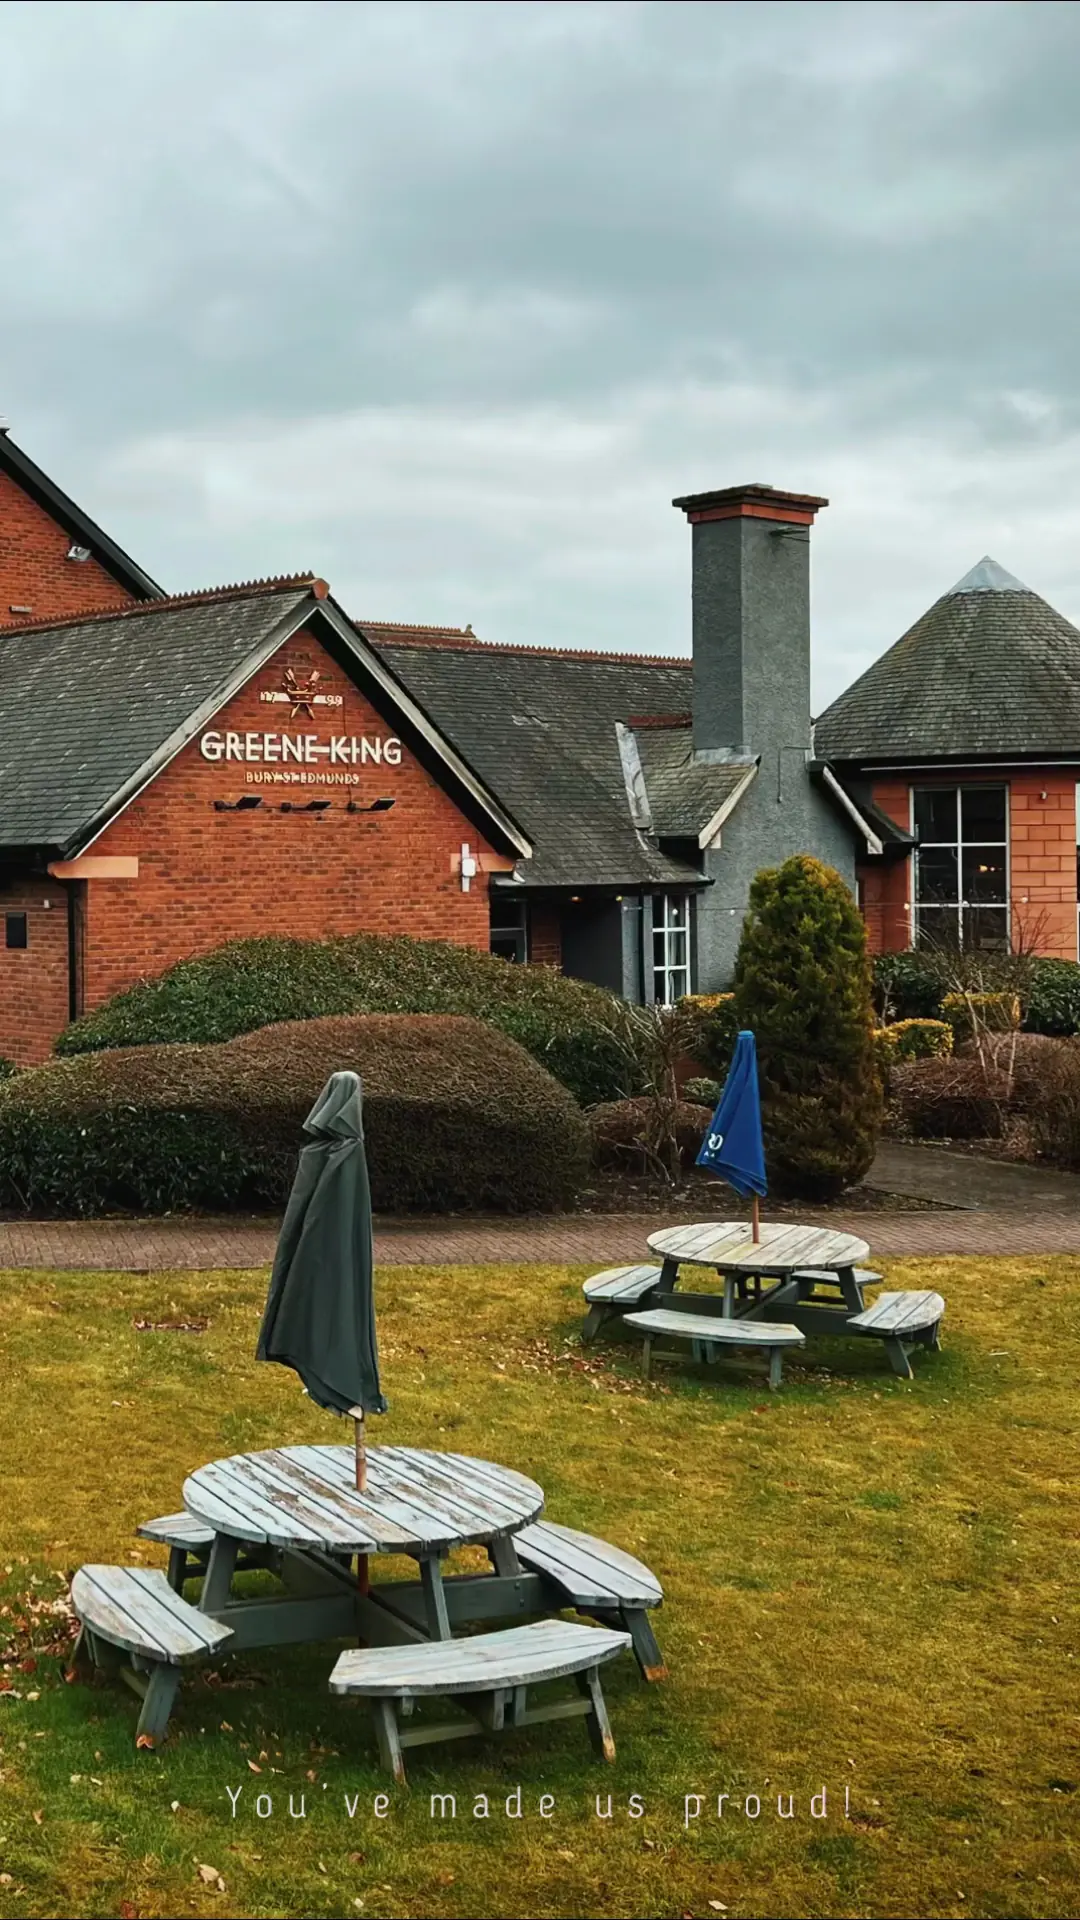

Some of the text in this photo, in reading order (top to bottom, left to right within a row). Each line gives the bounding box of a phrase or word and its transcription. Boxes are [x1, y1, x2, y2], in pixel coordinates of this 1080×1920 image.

[326, 694, 343, 706] 99
[200, 731, 402, 765] GREENE KING
[246, 771, 360, 785] BURY ST EDMUNDS
